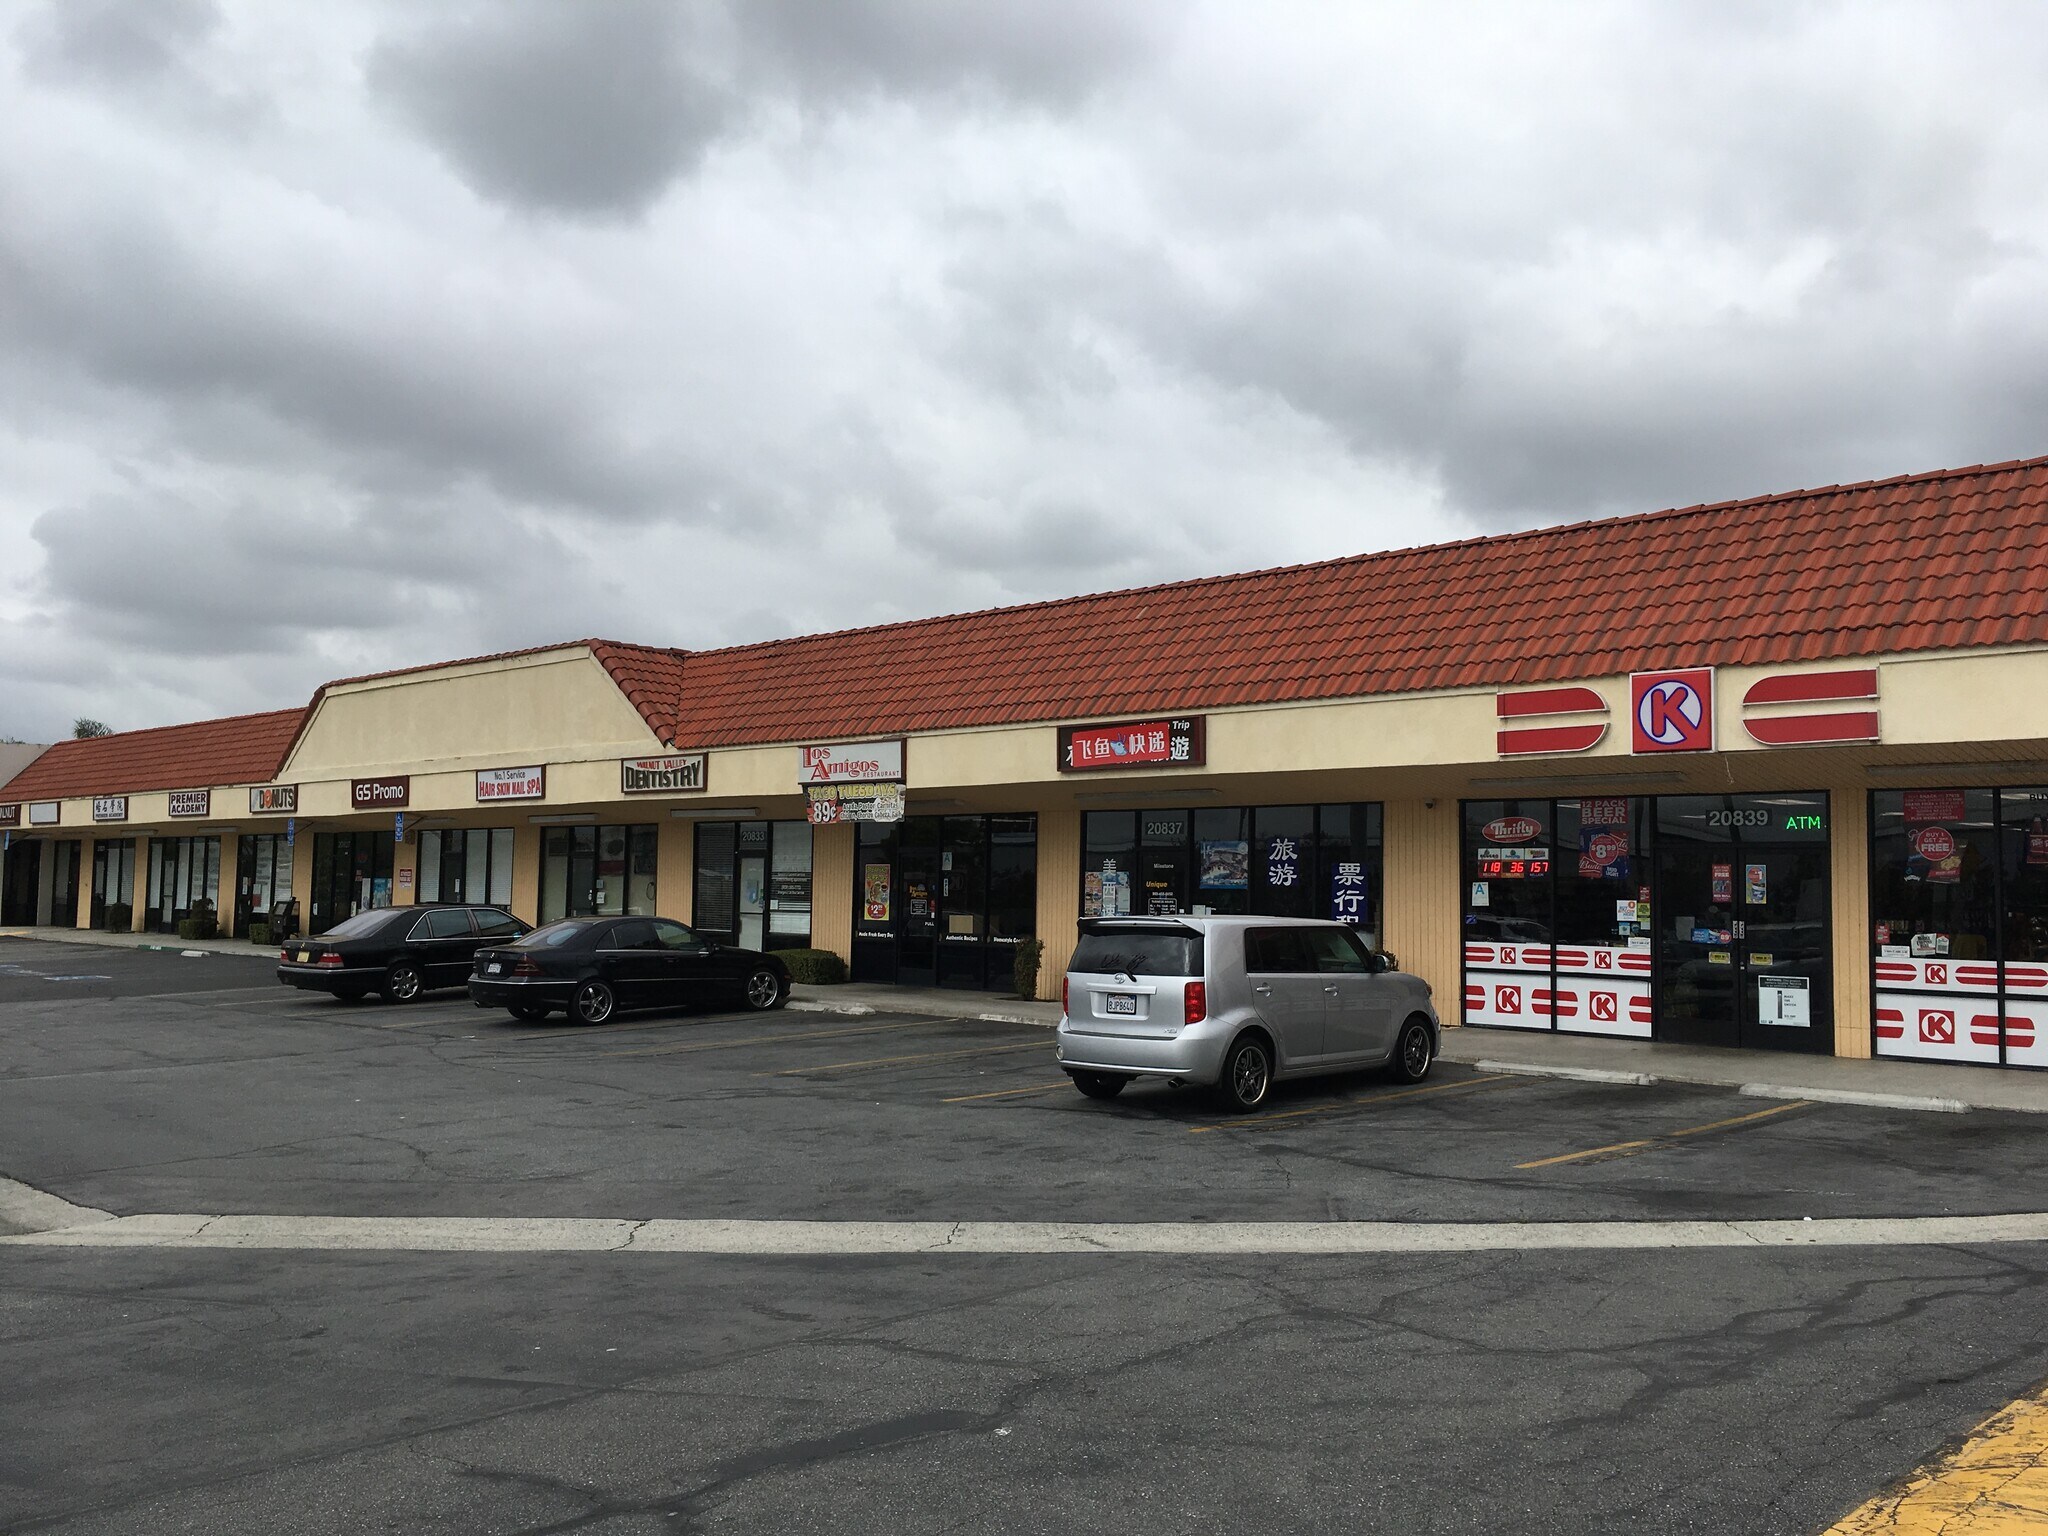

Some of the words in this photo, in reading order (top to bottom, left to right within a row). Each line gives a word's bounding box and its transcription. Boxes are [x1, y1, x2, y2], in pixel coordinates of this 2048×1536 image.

[1650, 686, 1698, 740] K
[1173, 720, 1191, 730] Trip
[1075, 731, 1165, 760] 飞鱼快递
[803, 746, 831, 768] Los
[664, 759, 687, 769] VALLEY
[811, 759, 879, 780] Amigos
[506, 770, 526, 779] Service
[625, 760, 701, 789] DENTISTRY
[862, 770, 900, 778] RESTAURANT
[356, 784, 371, 800] GS
[373, 783, 404, 800] Promo
[479, 781, 495, 797] HAIR
[497, 782, 511, 796] SKIN
[512, 781, 525, 795] NAIL
[527, 777, 541, 794] SPA
[808, 785, 837, 801] TACO
[838, 782, 897, 799] TUESDAYS
[170, 793, 206, 804] PREMIER
[259, 788, 294, 809] DONUTS
[171, 803, 206, 814] ACADEMY
[1581, 806, 1625, 817] BEER
[1581, 816, 1626, 825] SPECIAL
[1708, 809, 1769, 826] 20839
[1786, 816, 1821, 829] ATM
[1147, 822, 1182, 834] 20837
[1490, 821, 1534, 836] Thrifty
[742, 831, 765, 841] 20833
[1921, 843, 1950, 852] FREE
[1269, 838, 1298, 886] 旅游
[1510, 862, 1524, 873] 36
[1530, 861, 1549, 873] 157
[1475, 883, 1485, 894] A
